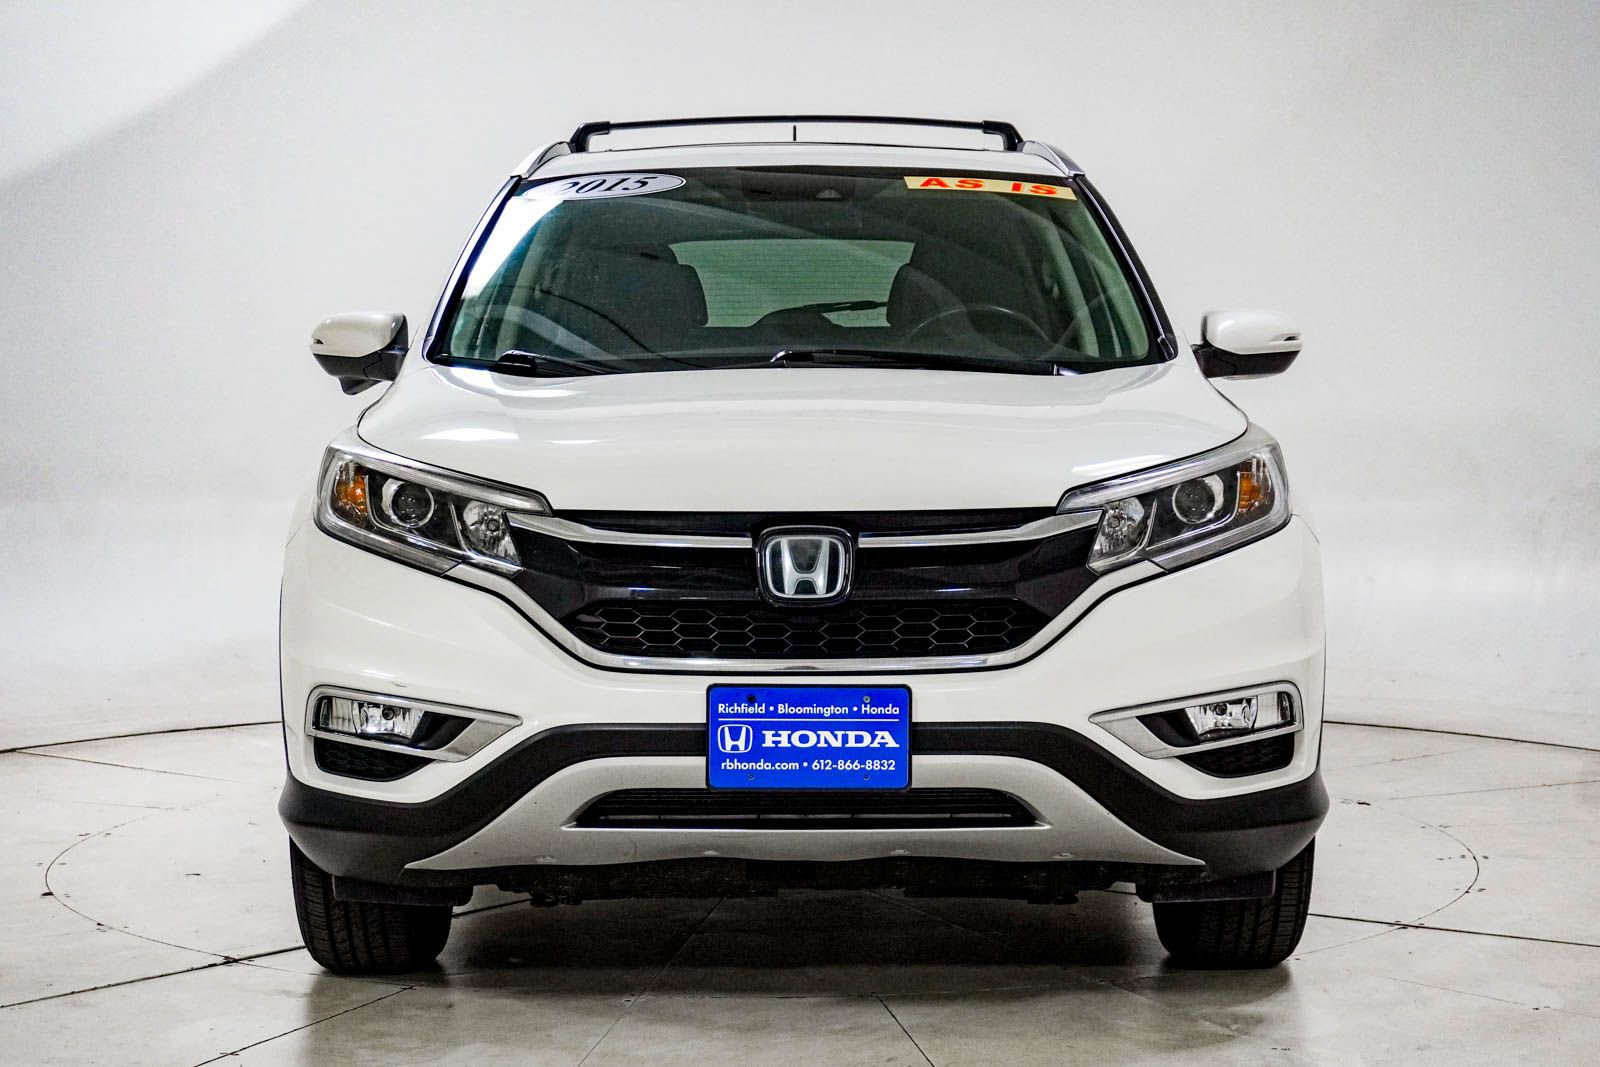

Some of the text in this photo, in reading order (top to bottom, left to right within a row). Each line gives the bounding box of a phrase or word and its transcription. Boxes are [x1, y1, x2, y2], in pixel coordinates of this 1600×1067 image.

[919, 177, 1057, 195] AS IS
[717, 703, 900, 717] Richfield Bloomington Honda
[761, 730, 900, 748] HONDA
[720, 758, 896, 770] rbhonda.com 612-866-8832
